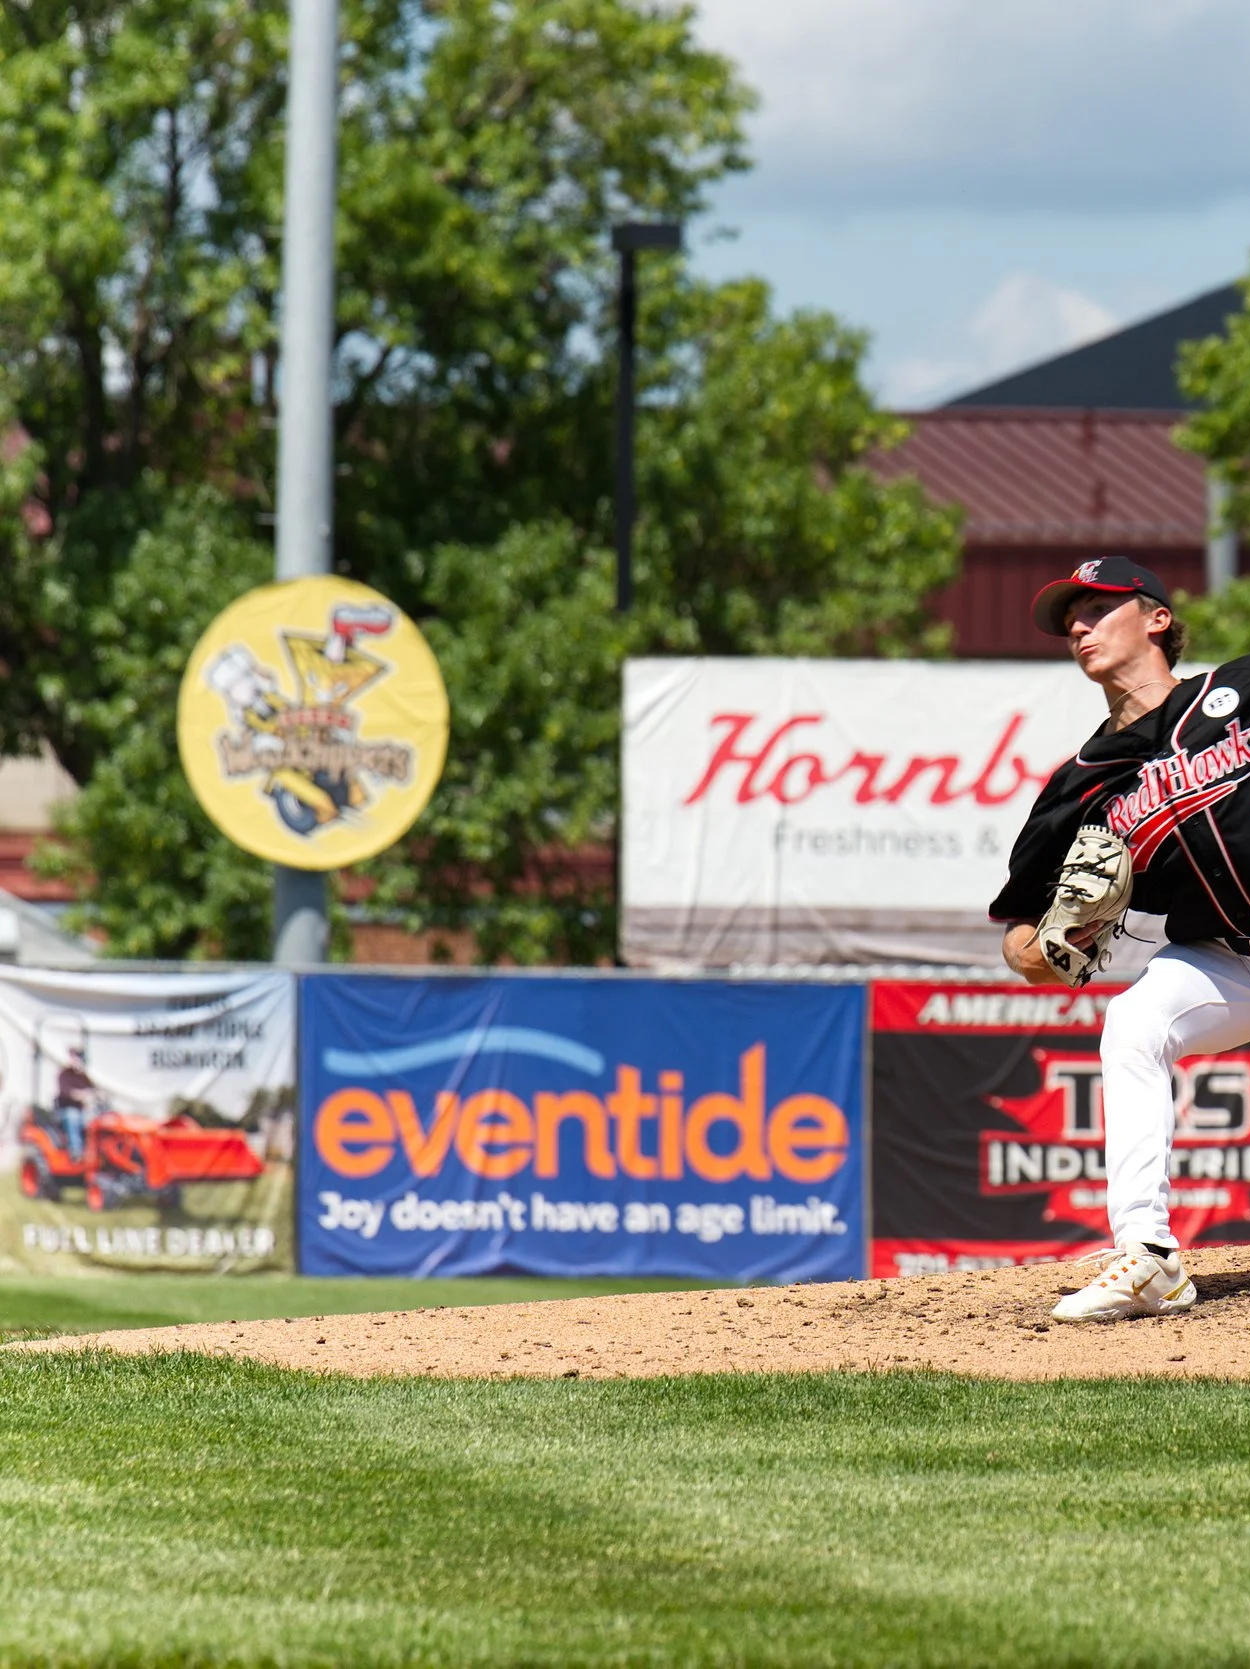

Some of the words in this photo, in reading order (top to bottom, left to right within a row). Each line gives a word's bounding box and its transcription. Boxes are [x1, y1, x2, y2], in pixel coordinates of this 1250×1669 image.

[775, 822, 964, 859] Freshness
[314, 1042, 850, 1184] eventide
[318, 1192, 385, 1239] Joy
[391, 1192, 527, 1233] doesn't
[532, 1193, 619, 1233] have
[624, 1200, 671, 1233] an
[676, 1201, 745, 1242] age
[751, 1195, 848, 1236] limit.
[23, 1223, 94, 1255] FULL
[97, 1225, 162, 1256] LINE
[166, 1227, 276, 1259] DEALER
